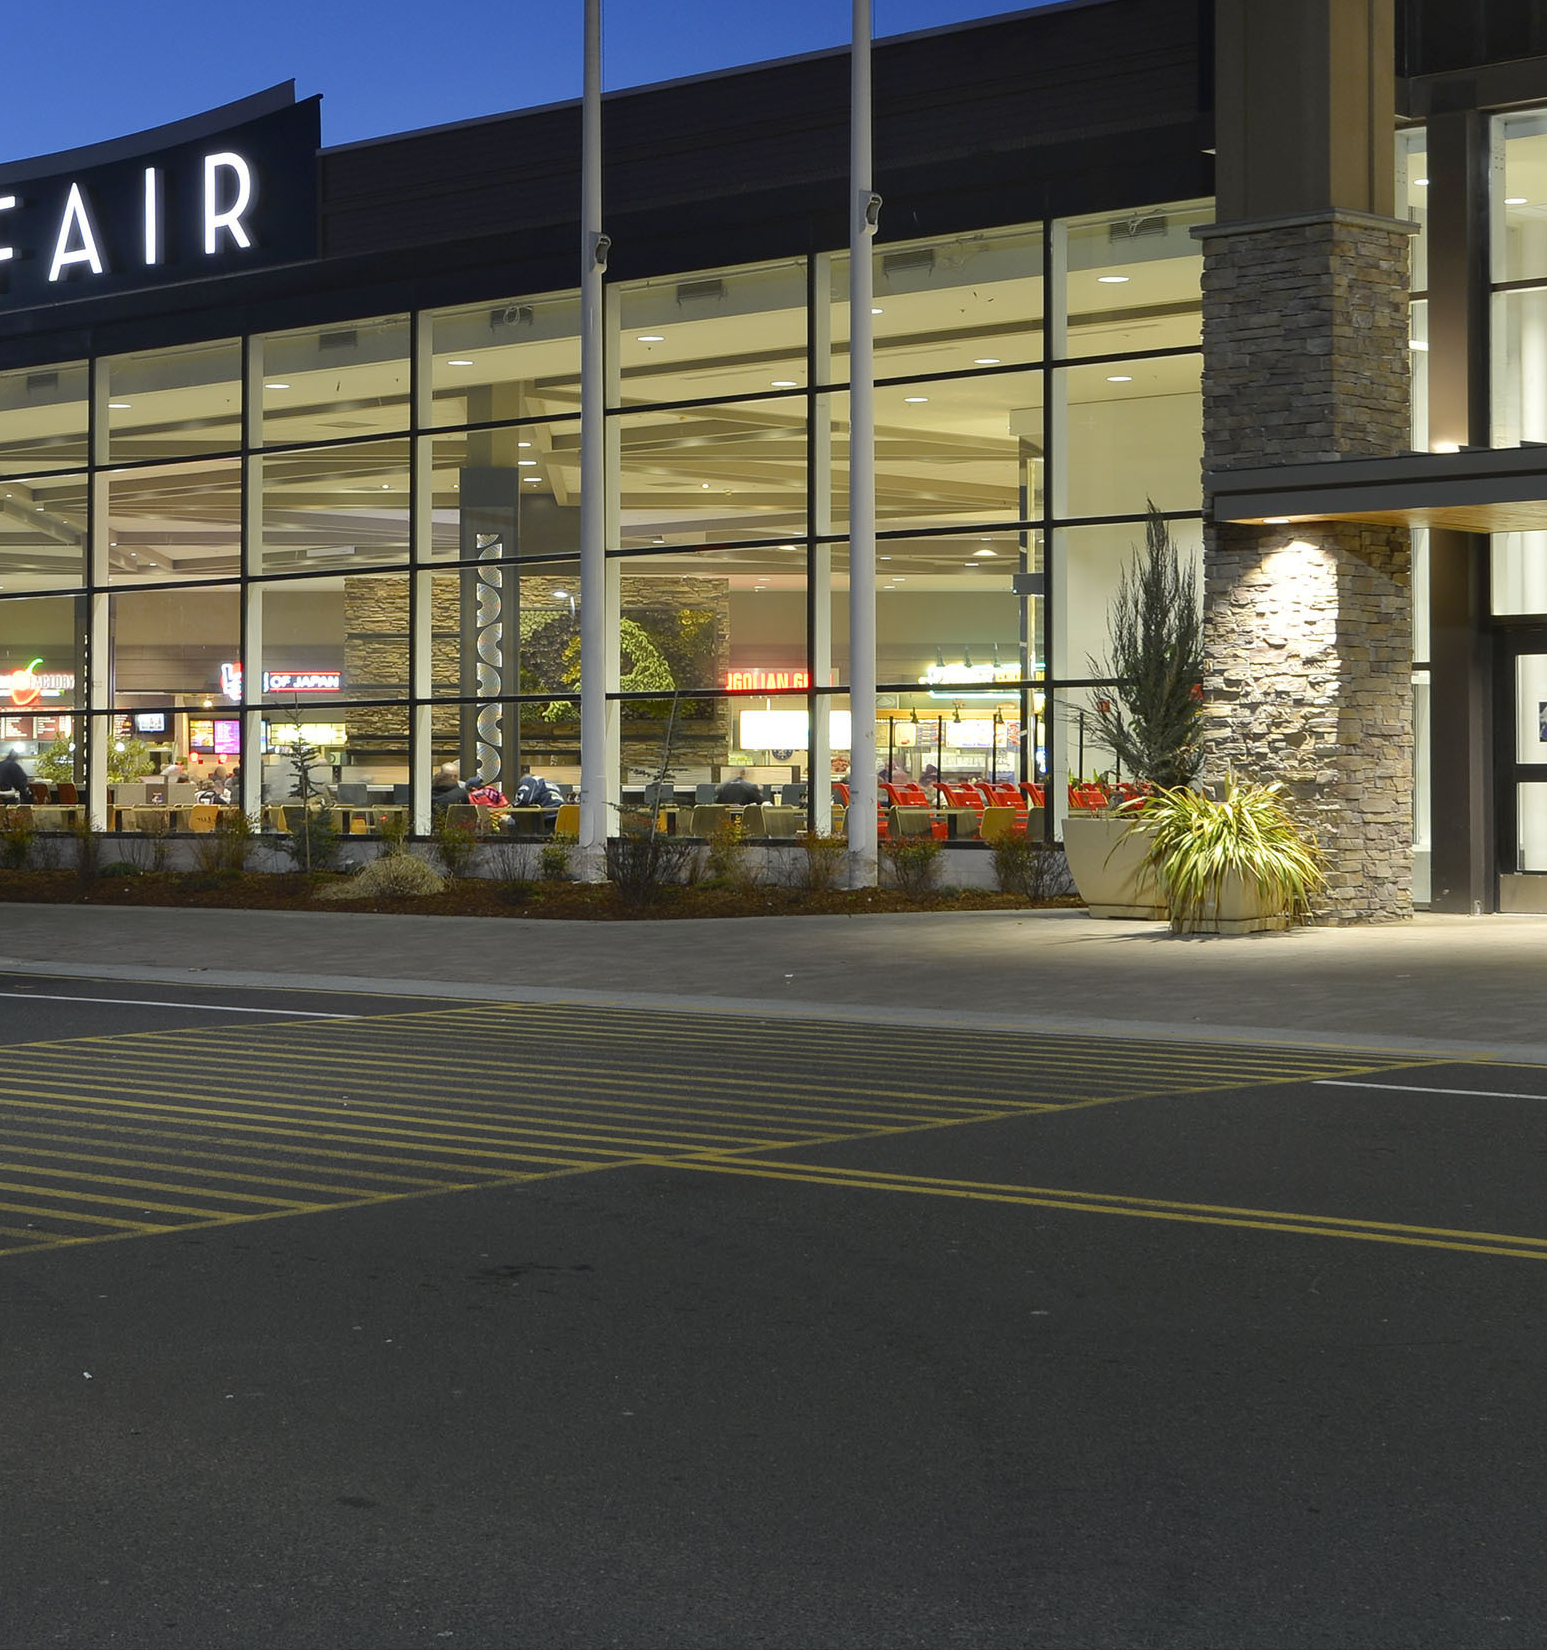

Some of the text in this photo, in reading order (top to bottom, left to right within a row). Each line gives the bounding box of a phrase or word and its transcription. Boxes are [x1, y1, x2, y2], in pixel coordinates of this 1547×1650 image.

[270, 675, 291, 688] OF
[293, 675, 340, 688] JAPAN
[726, 672, 789, 691] GOLIAN
